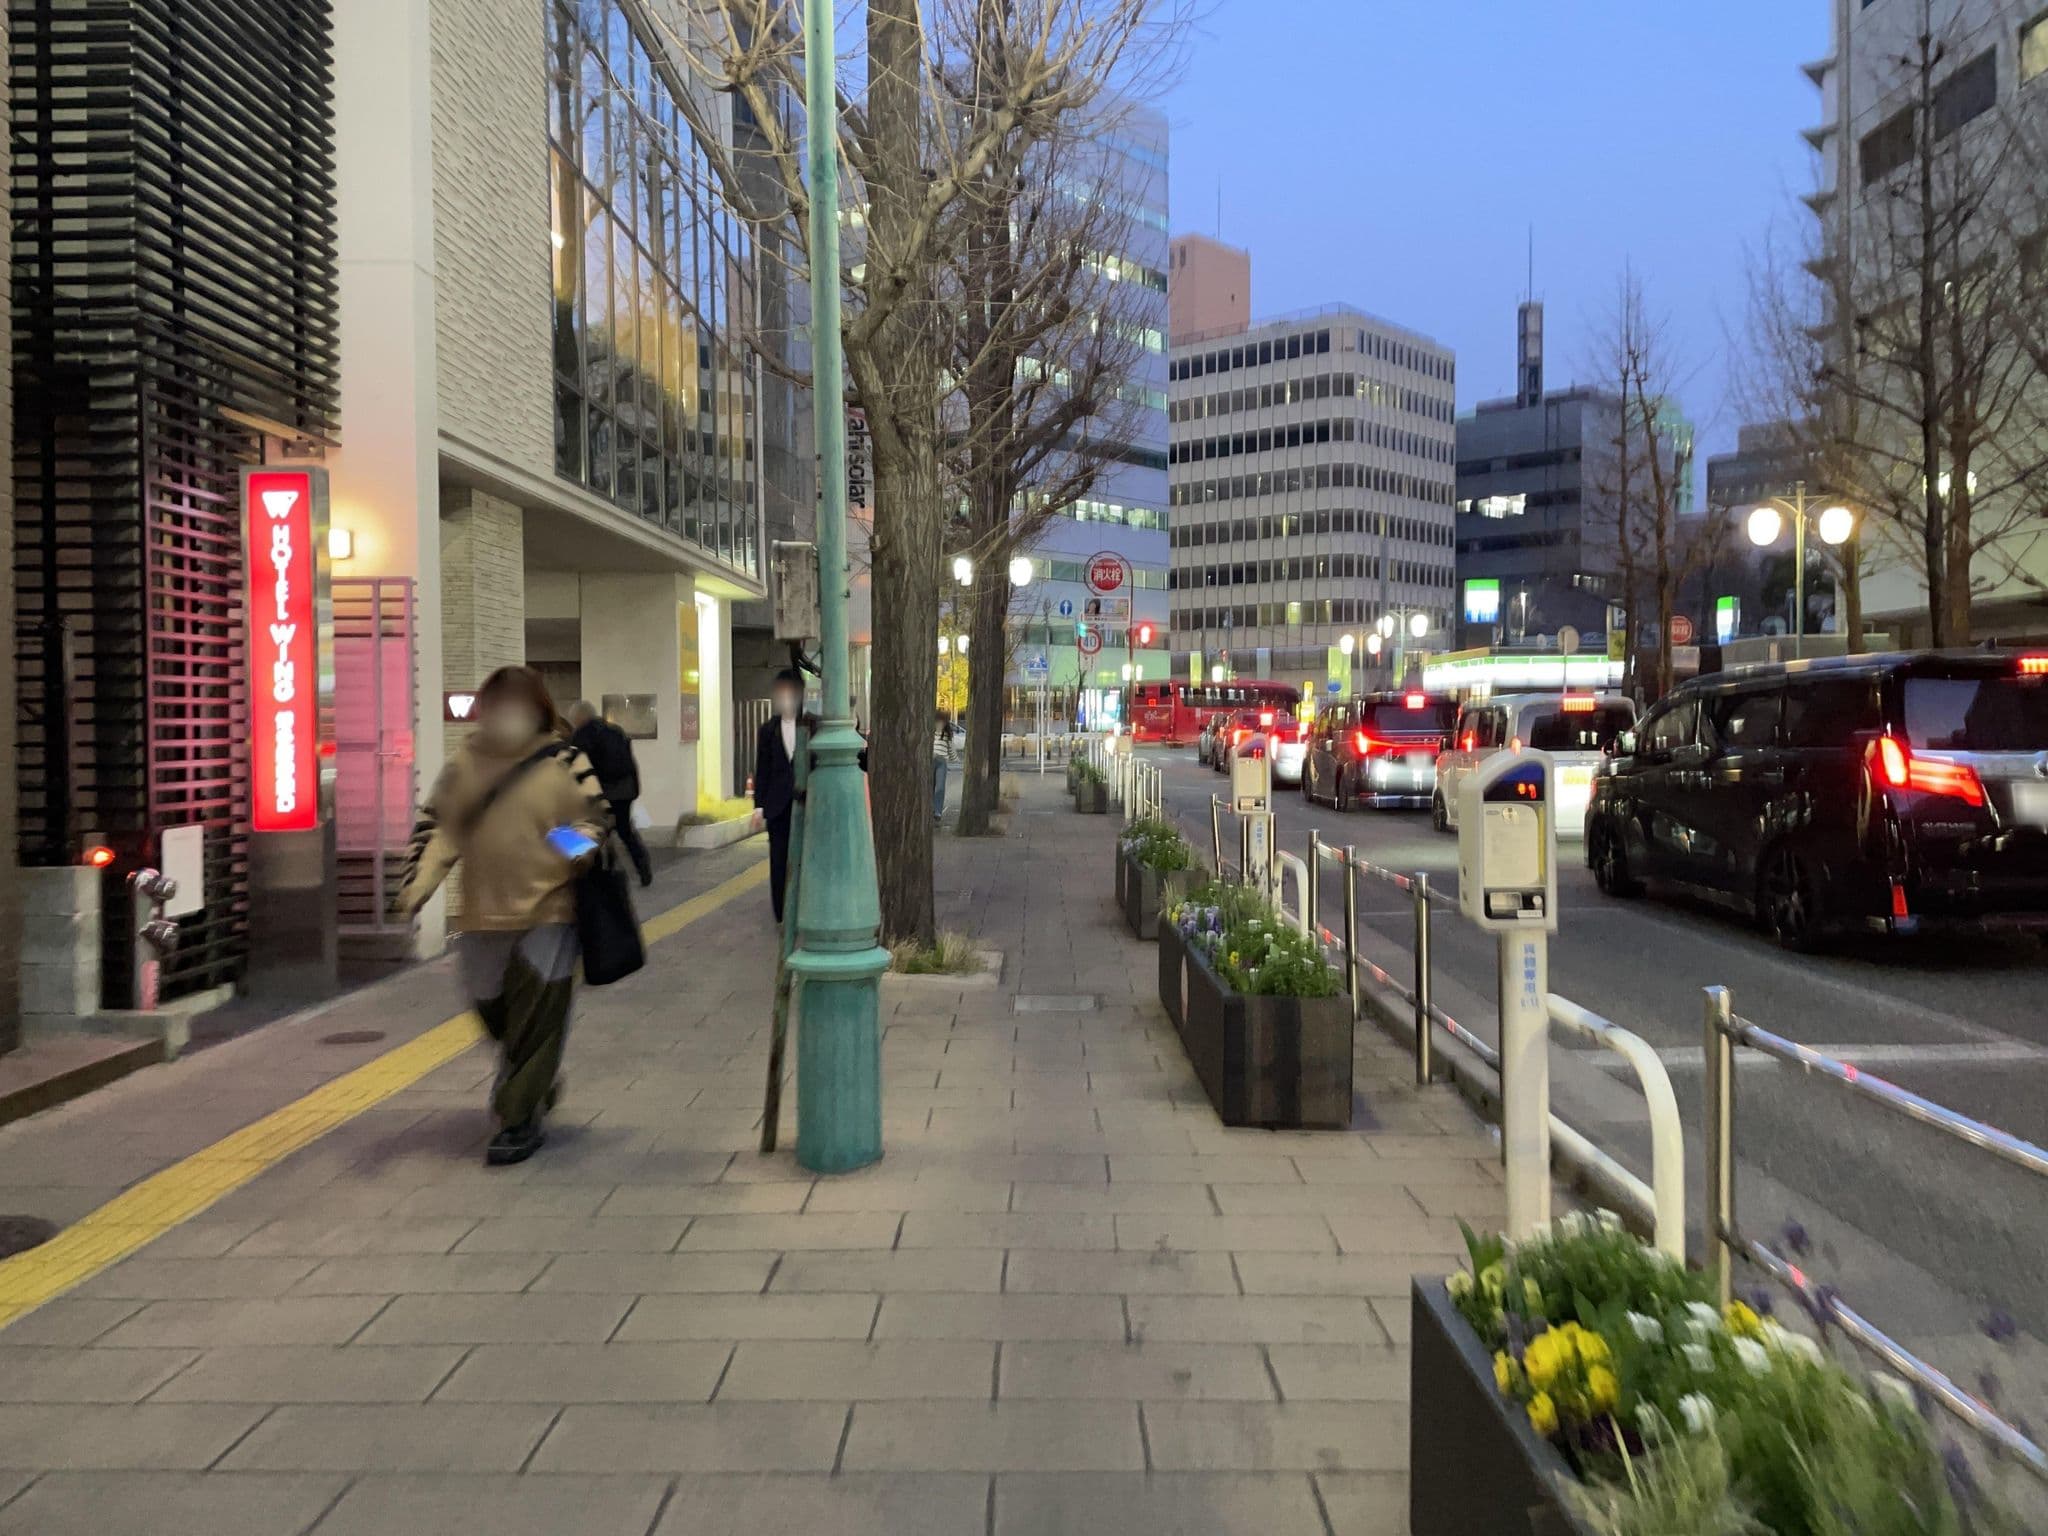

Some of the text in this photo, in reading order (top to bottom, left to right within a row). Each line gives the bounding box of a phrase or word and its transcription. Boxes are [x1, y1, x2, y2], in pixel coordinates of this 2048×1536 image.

[270, 524, 293, 621] HOTEL
[1092, 567, 1121, 583] 消火栓
[269, 623, 297, 703] WING
